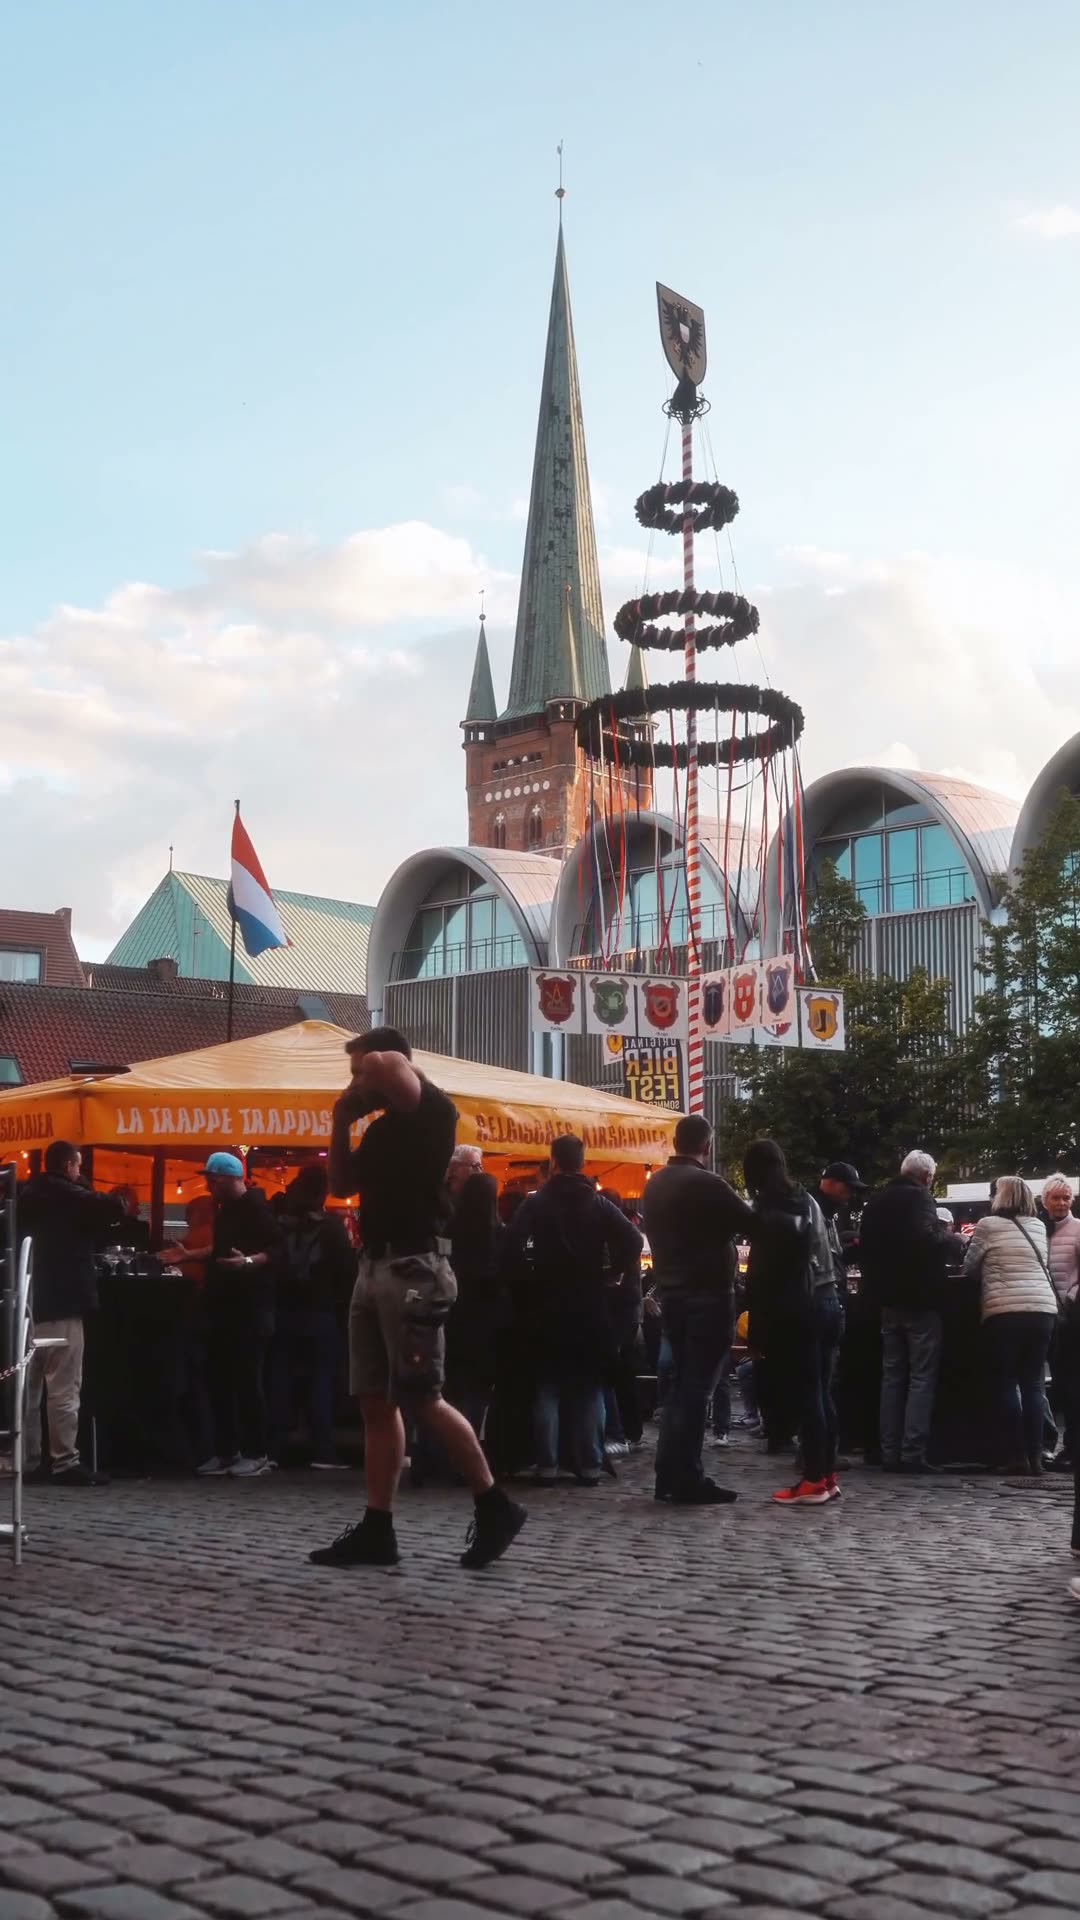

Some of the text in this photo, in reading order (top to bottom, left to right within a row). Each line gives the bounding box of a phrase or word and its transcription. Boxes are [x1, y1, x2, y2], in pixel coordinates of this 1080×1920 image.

[116, 1107, 144, 1135] LA
[151, 1106, 233, 1135] TRAPPE
[240, 1108, 333, 1137] TRAPPIS
